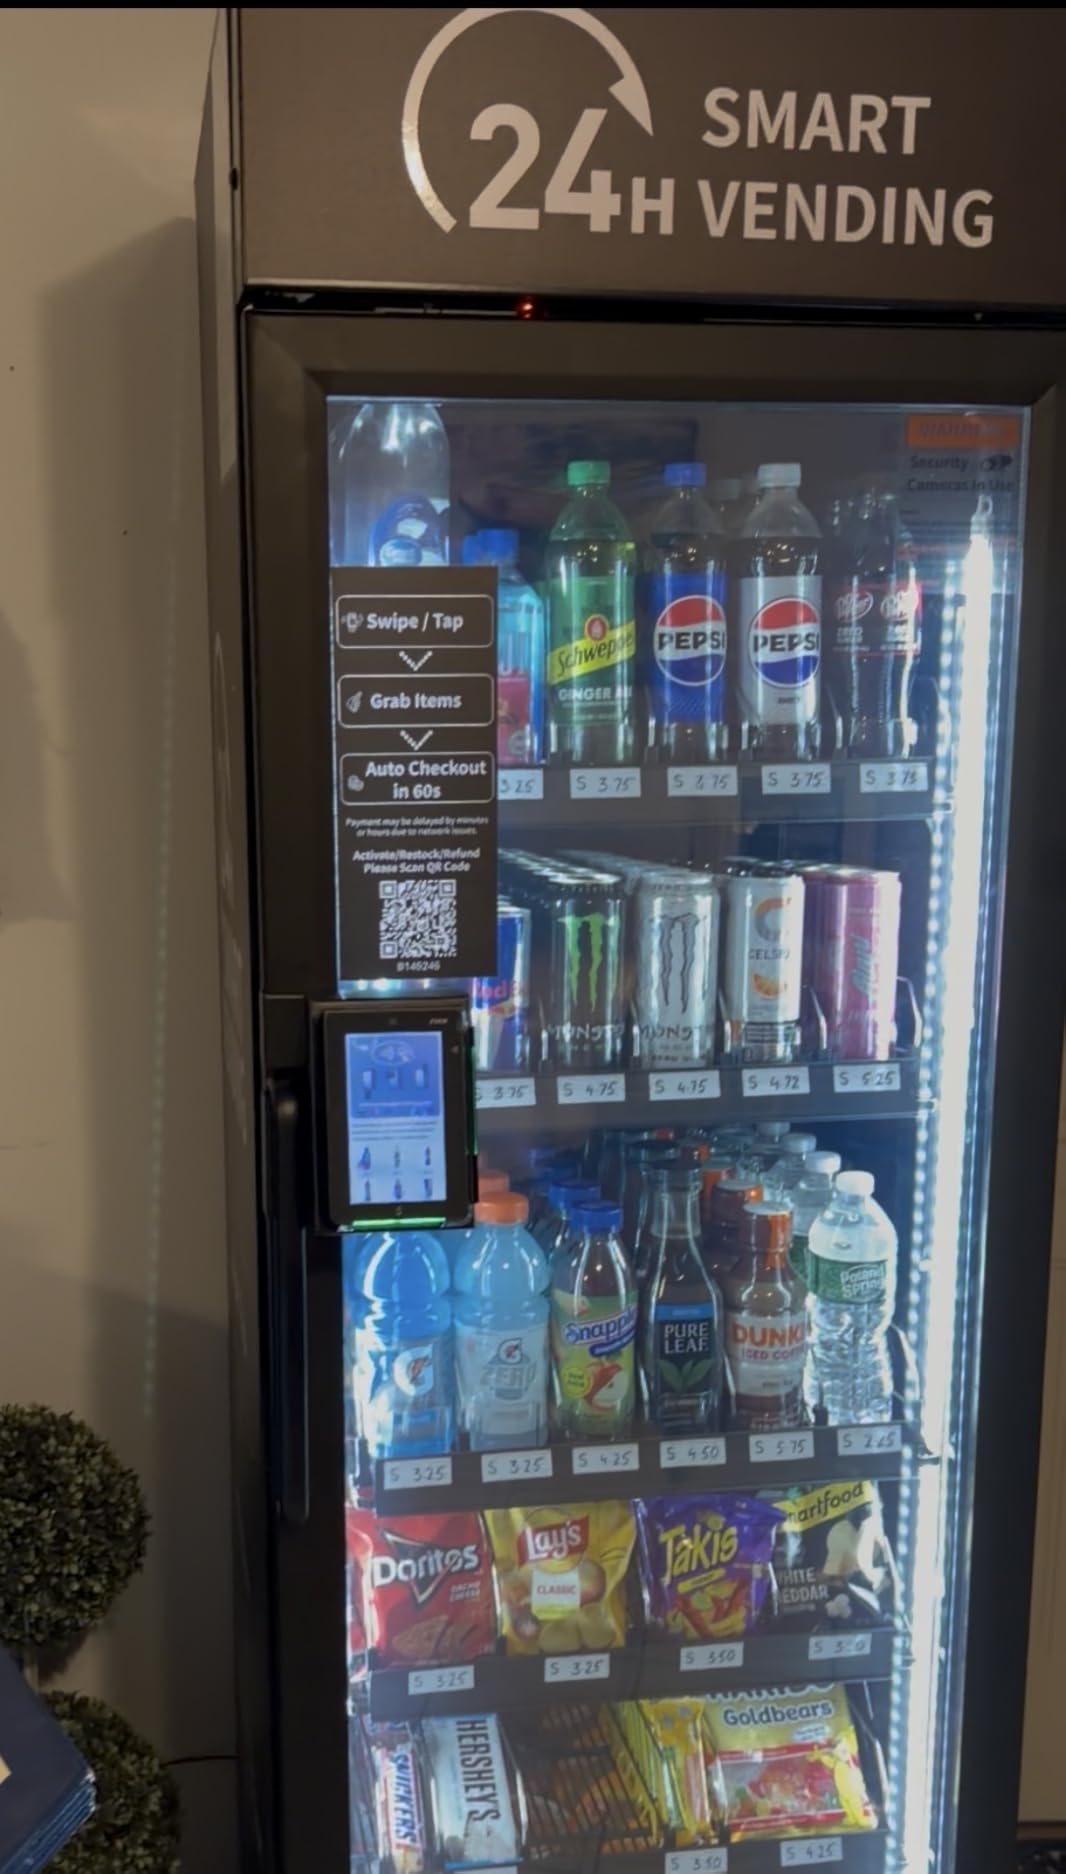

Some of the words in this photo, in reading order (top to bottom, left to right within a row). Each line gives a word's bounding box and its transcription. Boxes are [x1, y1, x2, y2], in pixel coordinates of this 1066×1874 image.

[701, 87, 931, 155] SMART
[697, 178, 994, 248] VENDING
[366, 612, 418, 631] Swipe
[422, 612, 429, 632] /
[432, 612, 464, 632] Tap
[658, 631, 725, 650] PEPSI
[753, 633, 819, 652] PEPSI
[557, 632, 634, 677] Schweppe
[370, 693, 411, 709] Grab
[415, 693, 462, 709] Items
[558, 687, 611, 701] GINGER
[366, 762, 407, 777] Auto
[410, 760, 487, 776] Checkout
[392, 784, 408, 799] in
[413, 784, 441, 799] 60s
[345, 818, 381, 828] Payment
[413, 816, 444, 827] delayed
[352, 848, 480, 861] Activate/Restock/Refund
[364, 863, 397, 874] Please
[399, 862, 424, 873] Scan
[427, 863, 441, 874] QR
[444, 862, 470, 872] Code
[547, 1024, 626, 1041] MONST
[640, 1024, 710, 1041] MONST
[565, 1306, 637, 1343] Snappl
[664, 1322, 709, 1339] PURE
[732, 1321, 805, 1347] DUNK
[664, 1338, 708, 1354] LEAF
[786, 1482, 864, 1525] artfood
[525, 1520, 582, 1562] Lay's
[658, 1523, 738, 1586] Takis
[372, 1544, 480, 1586] Doritos
[536, 1584, 577, 1595] CLASSIC
[781, 1584, 829, 1603] EDDAR
[723, 1701, 833, 1726] Goldbears
